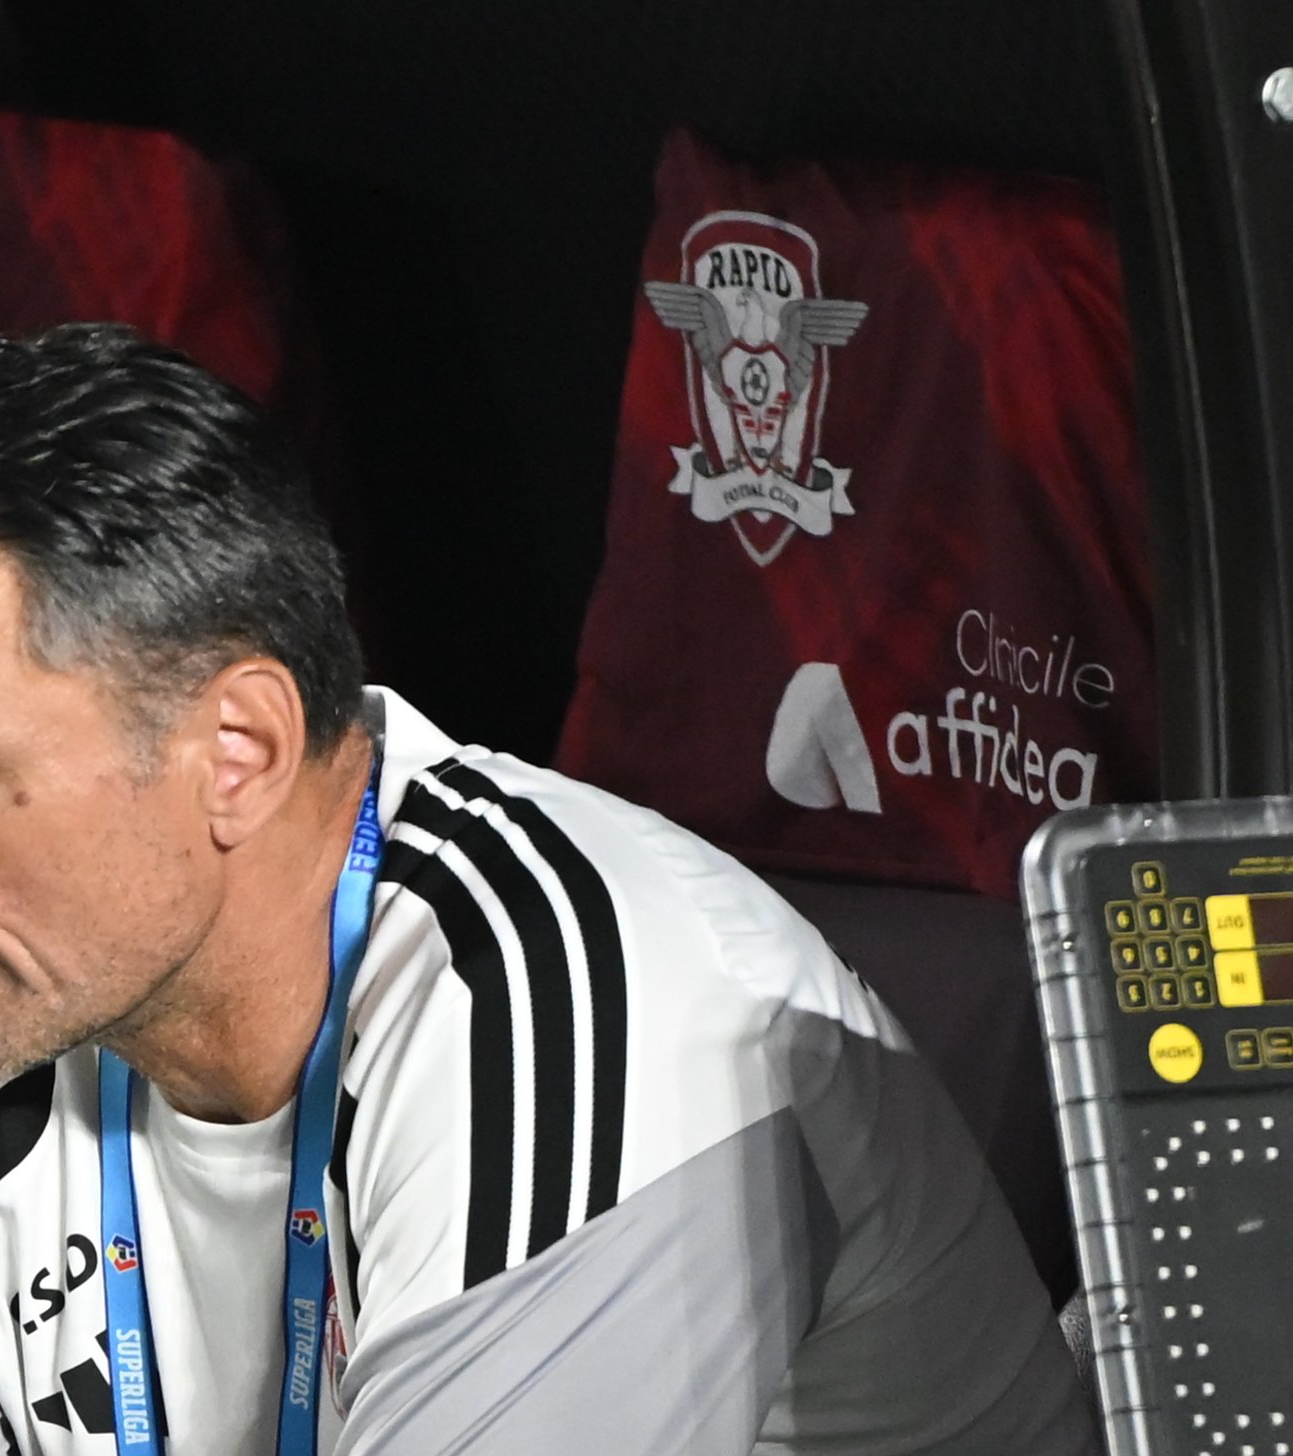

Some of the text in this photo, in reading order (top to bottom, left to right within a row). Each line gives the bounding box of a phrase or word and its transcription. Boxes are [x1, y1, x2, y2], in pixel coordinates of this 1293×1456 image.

[707, 248, 792, 298] RAPID
[887, 687, 1098, 811] affidea
[1216, 916, 1245, 929] OUT
[1230, 973, 1245, 985] IN
[1154, 1046, 1195, 1059] SHOW
[290, 1297, 316, 1410] SUPERLIGA
[115, 1328, 150, 1445] SUPERLIGA
